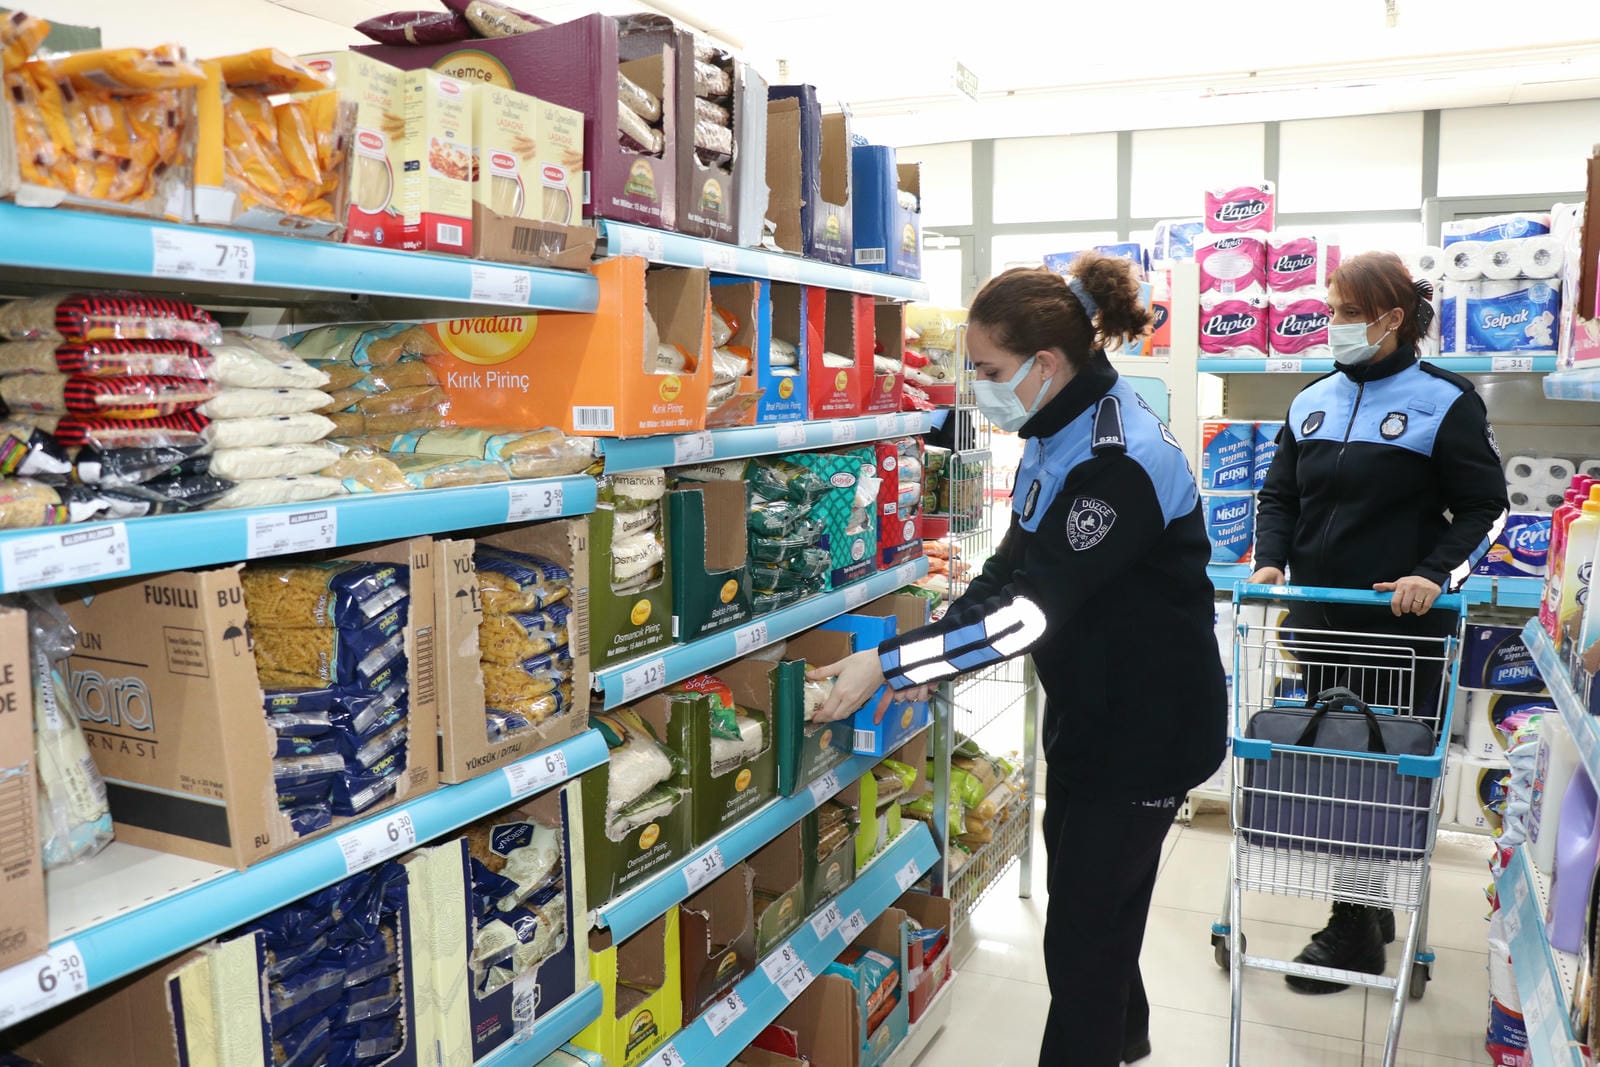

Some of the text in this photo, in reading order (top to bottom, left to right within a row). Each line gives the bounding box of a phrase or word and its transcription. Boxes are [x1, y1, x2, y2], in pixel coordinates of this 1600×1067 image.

[1220, 198, 1263, 221] Papia
[1275, 253, 1315, 272] Papia
[449, 315, 524, 336] Ovadan
[1205, 312, 1253, 336] Papia
[1279, 311, 1330, 336] Papia
[1481, 308, 1530, 330] Selpak
[1281, 361, 1293, 369] 50
[446, 371, 530, 393] Kırık Pirinç
[1218, 465, 1249, 485] Mistral
[543, 489, 563, 508] 3,50
[1082, 499, 1112, 517] DÜZCE
[1215, 503, 1247, 522] Mistral
[144, 585, 199, 609] FUSILLI
[614, 624, 661, 645] Osmancık Pirinç
[751, 628, 761, 644] 13
[644, 667, 657, 685] 12
[1497, 665, 1535, 682] Mistral
[466, 752, 497, 771] YÜKSÜK
[823, 776, 834, 789] 31
[386, 815, 411, 842] 6,30
[254, 833, 270, 848] BU
[702, 854, 717, 872] 31
[825, 909, 835, 923] 10
[782, 949, 790, 961] 8
[37, 954, 80, 993] 6,30
[794, 967, 805, 983] 17
[727, 997, 736, 1010] 8
[662, 1052, 672, 1067] 8
